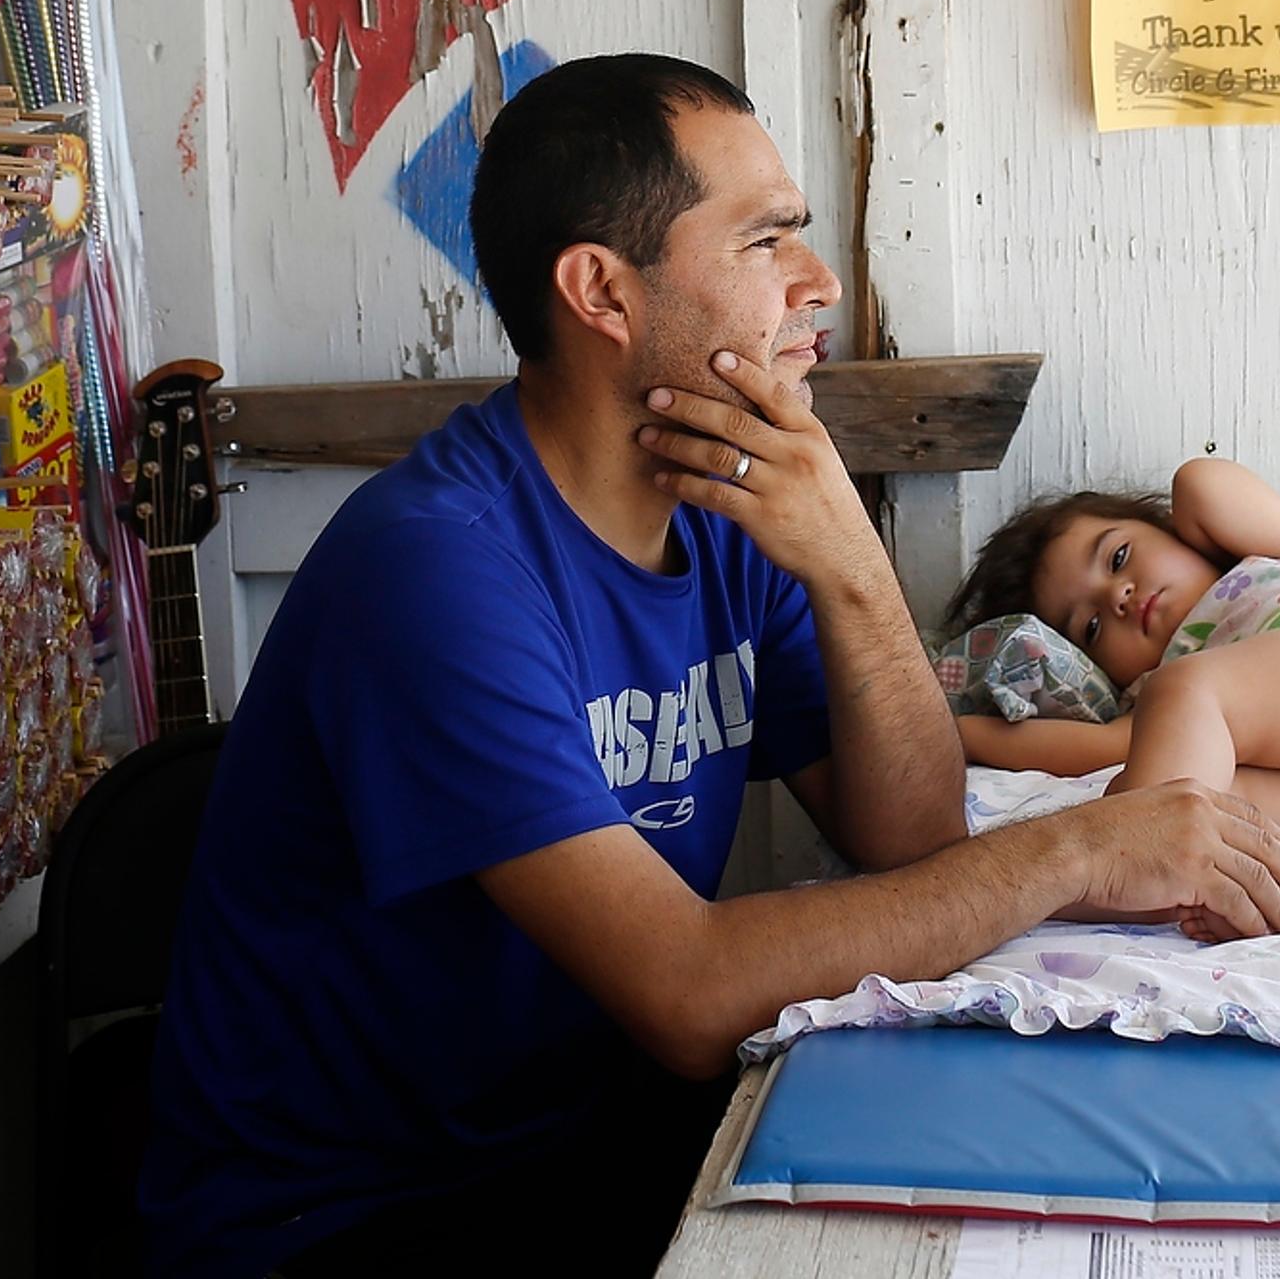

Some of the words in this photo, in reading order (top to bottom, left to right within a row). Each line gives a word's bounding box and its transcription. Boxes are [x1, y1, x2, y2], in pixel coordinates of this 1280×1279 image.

[1142, 15, 1263, 51] Thank
[1131, 69, 1206, 96] Circle
[1215, 71, 1236, 97] G
